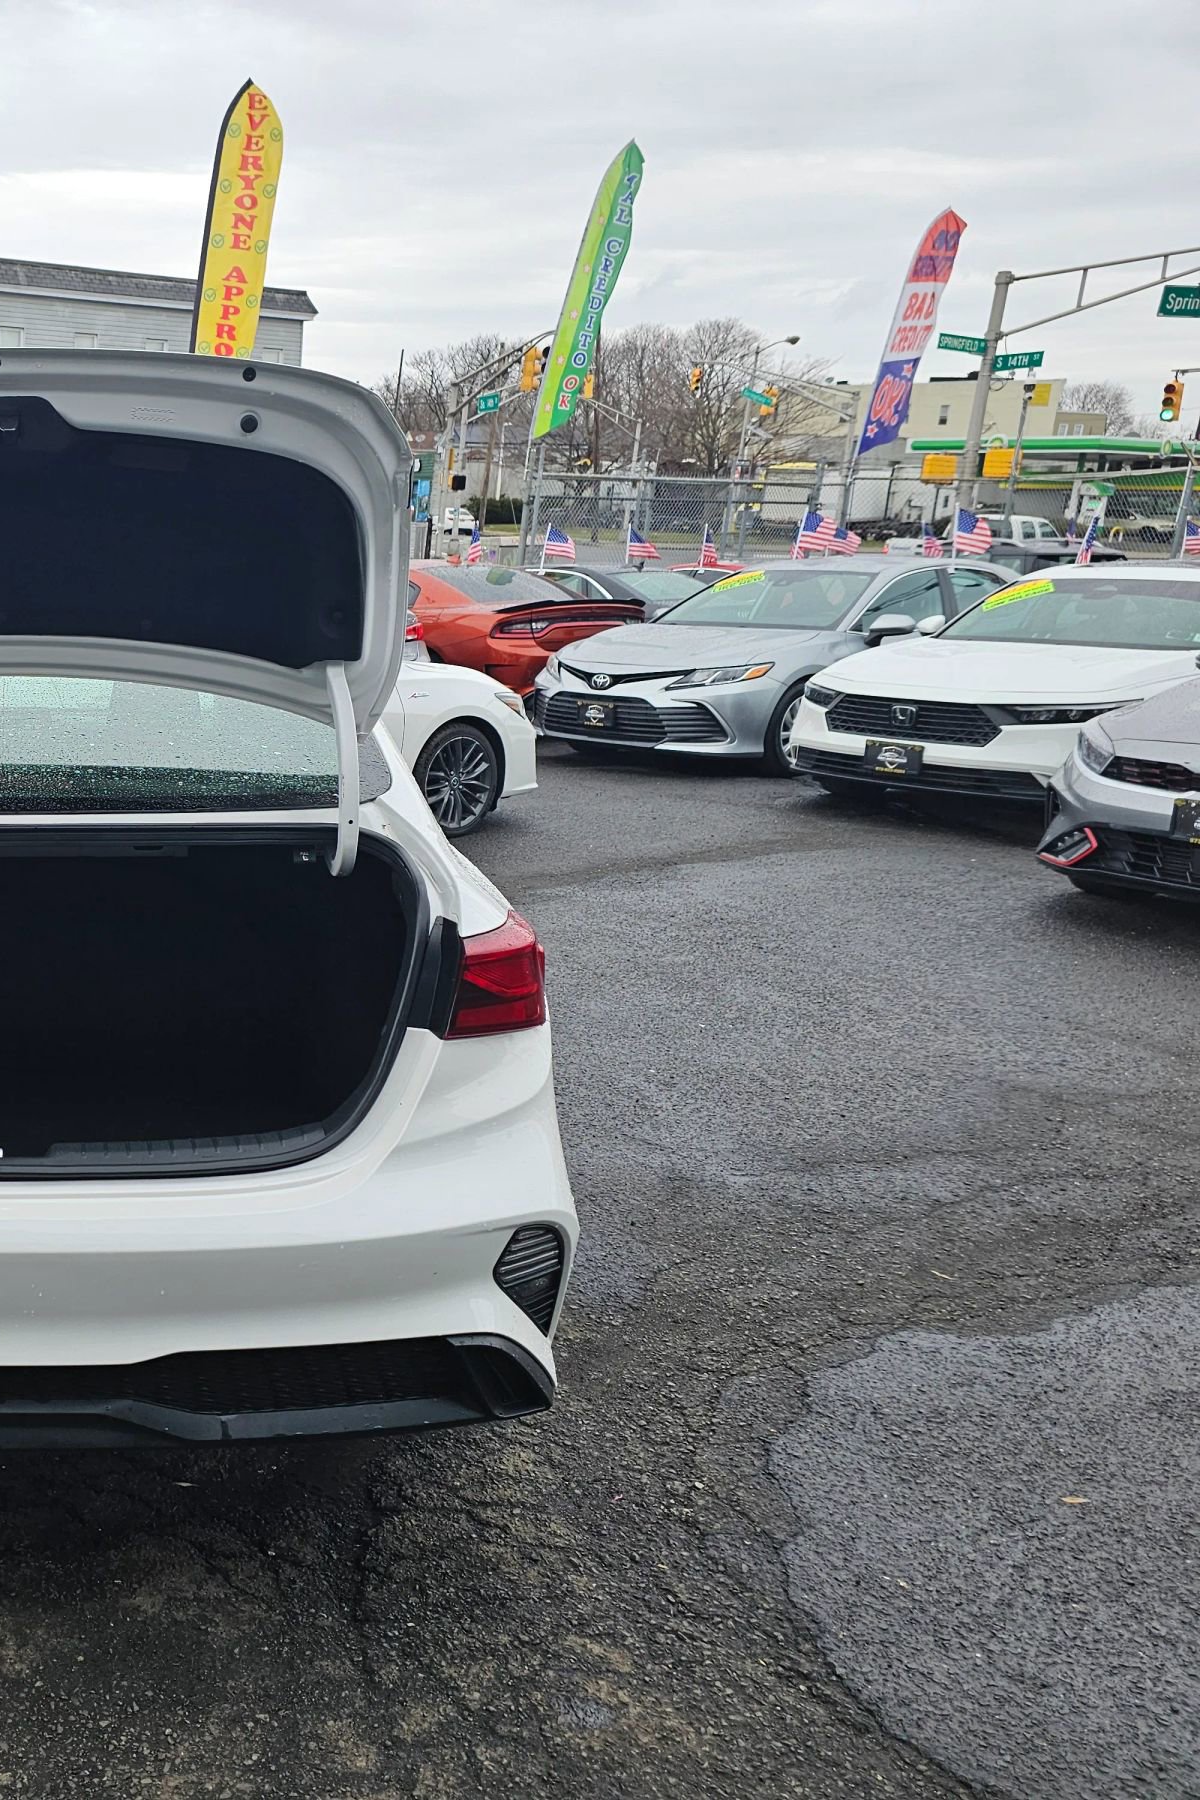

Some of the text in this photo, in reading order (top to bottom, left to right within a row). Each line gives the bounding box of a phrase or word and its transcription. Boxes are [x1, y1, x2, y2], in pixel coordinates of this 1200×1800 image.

[230, 93, 270, 251] EVERYONE
[573, 239, 624, 367] CREDITO
[902, 291, 936, 321] BAD
[1166, 292, 1200, 313] Sprin
[940, 336, 979, 351] SPRINGFIELD
[996, 357, 1003, 368] S
[1008, 354, 1029, 367] 14TH
[557, 374, 578, 410] OK
